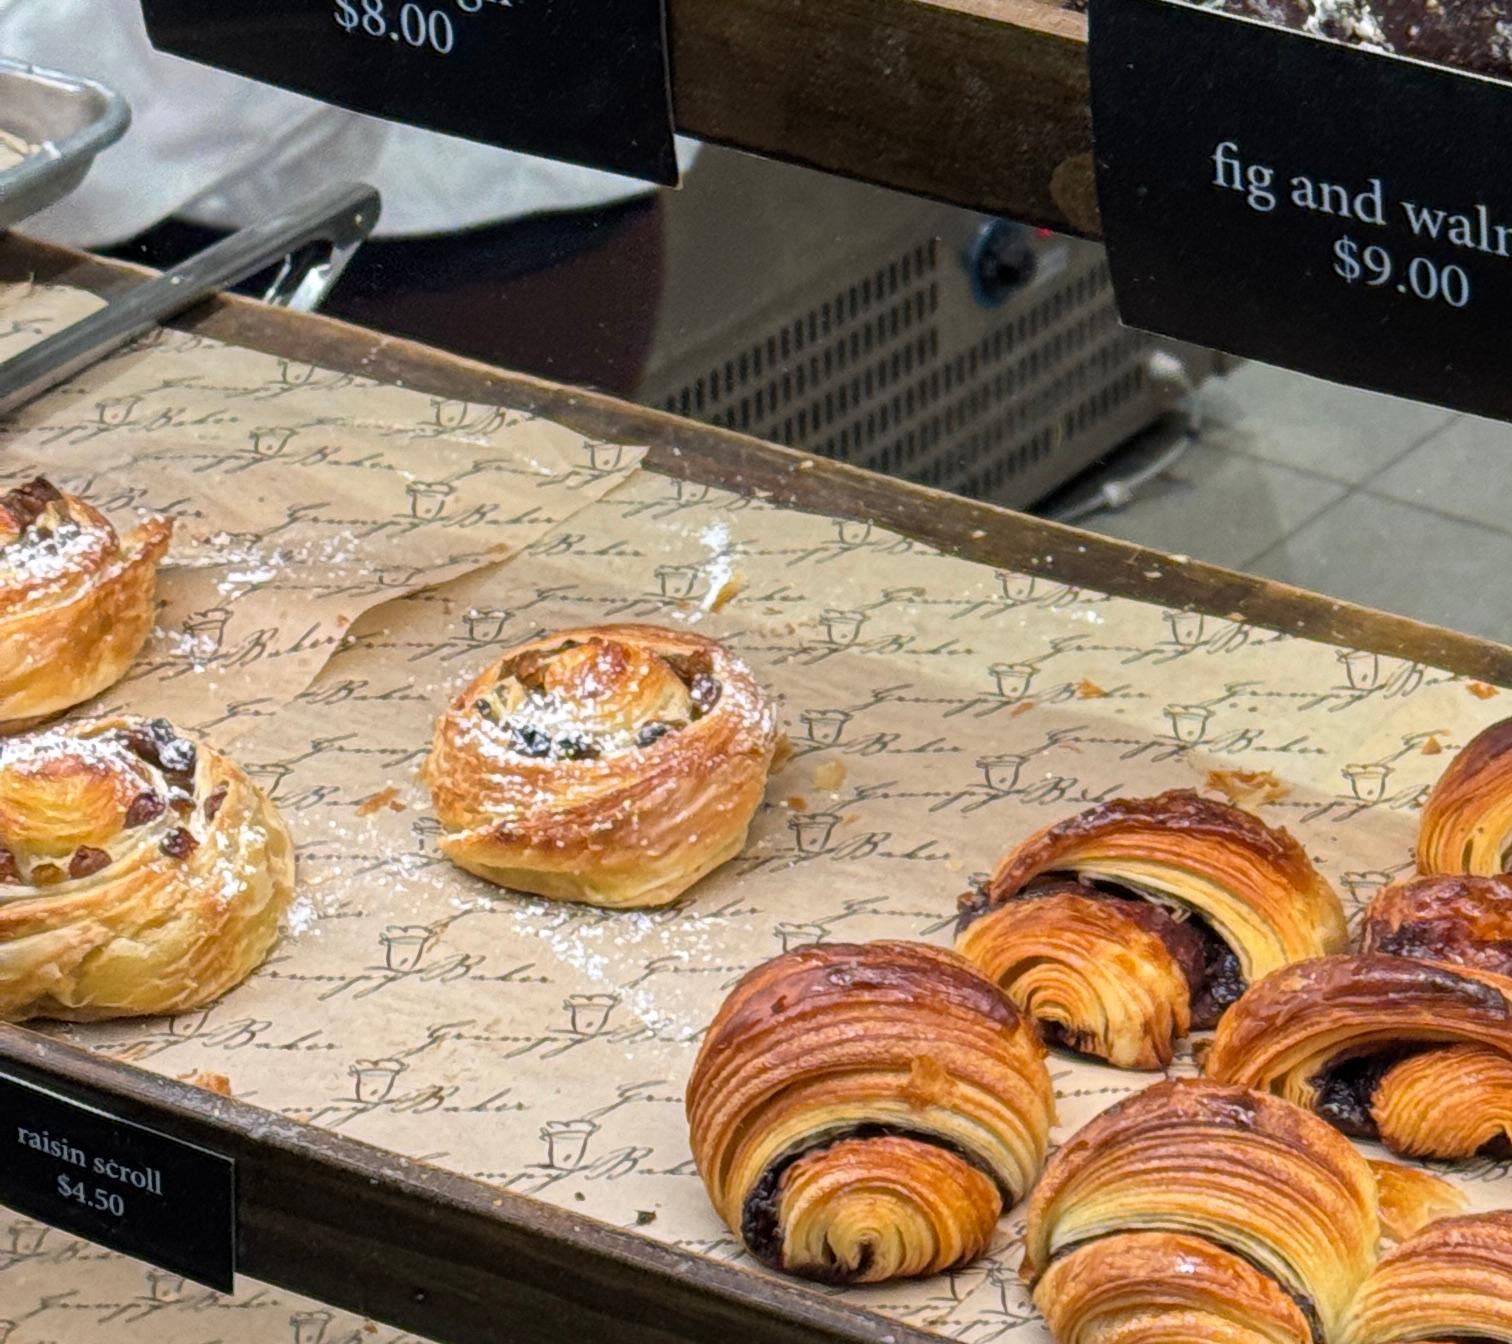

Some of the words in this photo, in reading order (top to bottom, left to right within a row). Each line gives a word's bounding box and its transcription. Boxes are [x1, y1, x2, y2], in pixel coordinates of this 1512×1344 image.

[1210, 141, 1276, 212] fig
[1289, 177, 1387, 226] and
[1333, 234, 1470, 307] $9.00
[18, 1127, 86, 1168] raisin
[93, 1156, 163, 1196] scroll
[57, 1173, 125, 1217] $4.50
